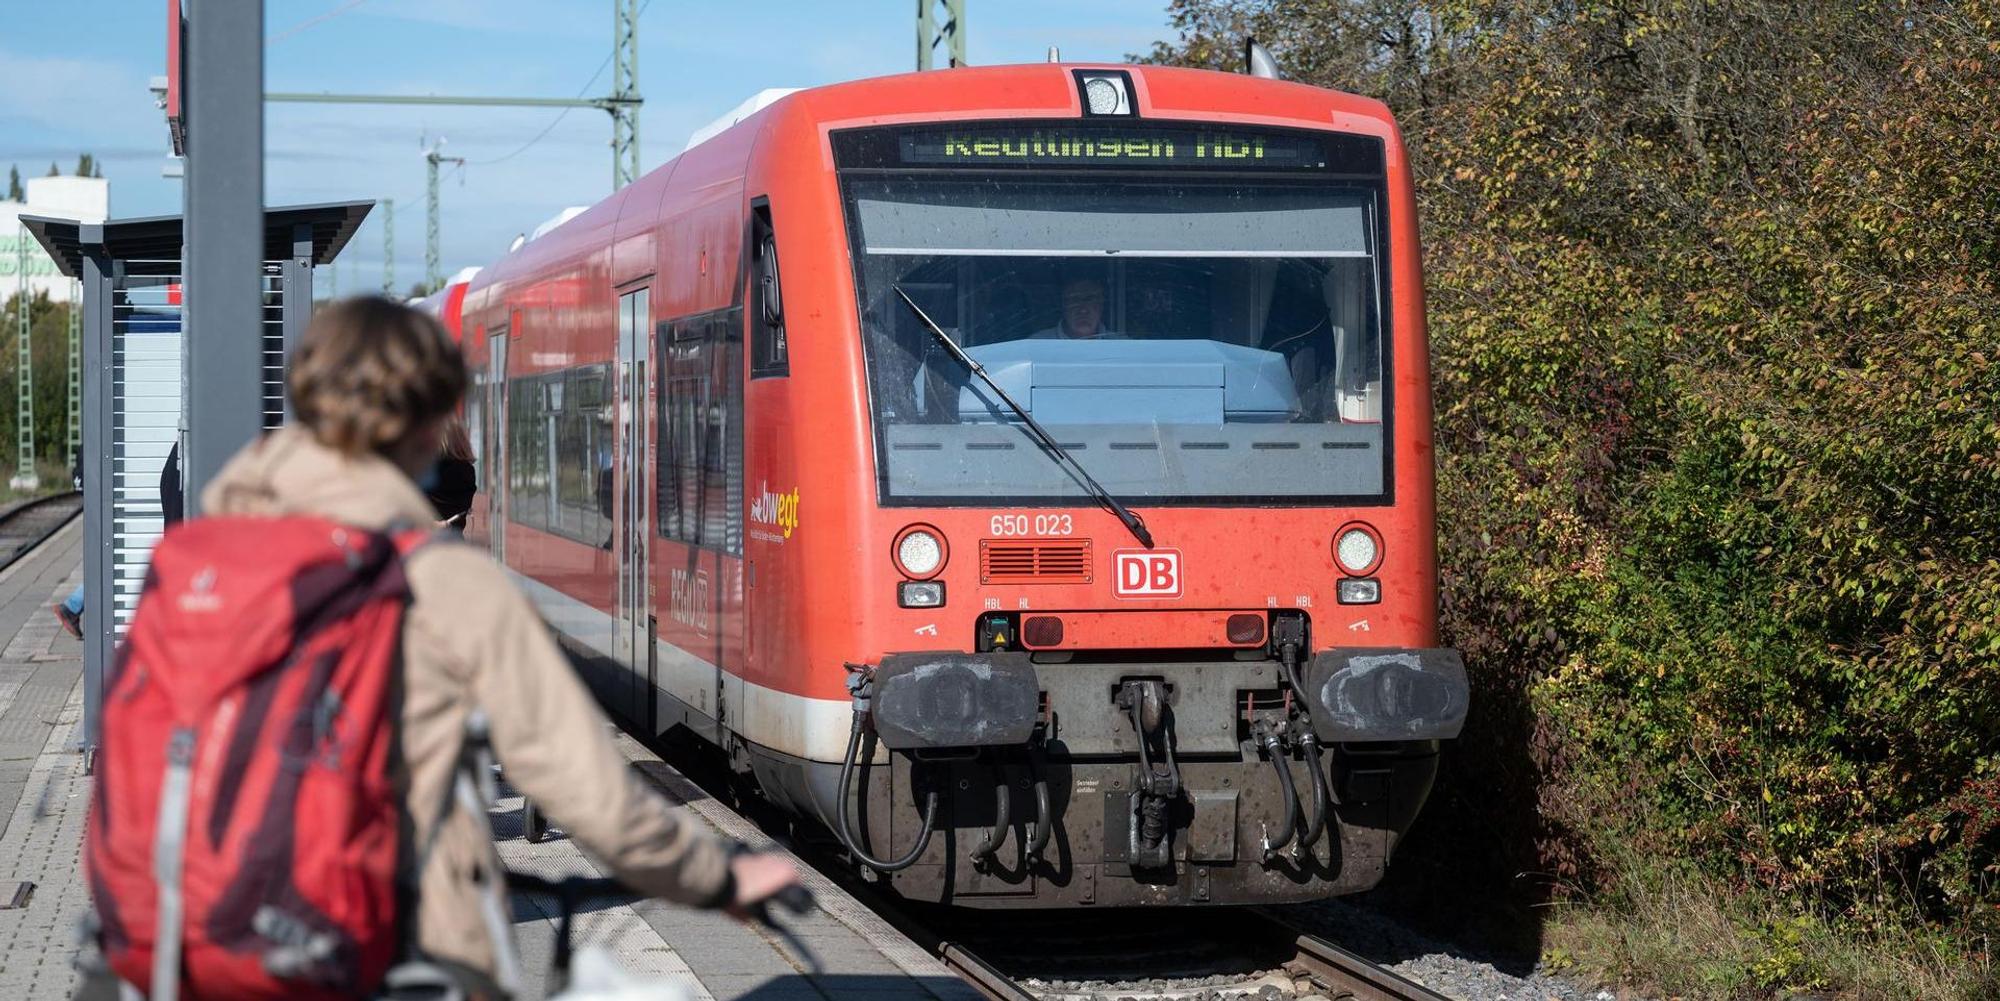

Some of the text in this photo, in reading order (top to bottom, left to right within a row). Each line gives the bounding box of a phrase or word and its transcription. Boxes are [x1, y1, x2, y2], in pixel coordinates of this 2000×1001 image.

[762, 480, 799, 538] bwegt
[990, 514, 1073, 536] 650 023
[1121, 557, 1175, 591] DB
[671, 567, 696, 628] REGIO
[984, 597, 1030, 610] HBL HL
[1267, 595, 1313, 608] HL HBL
